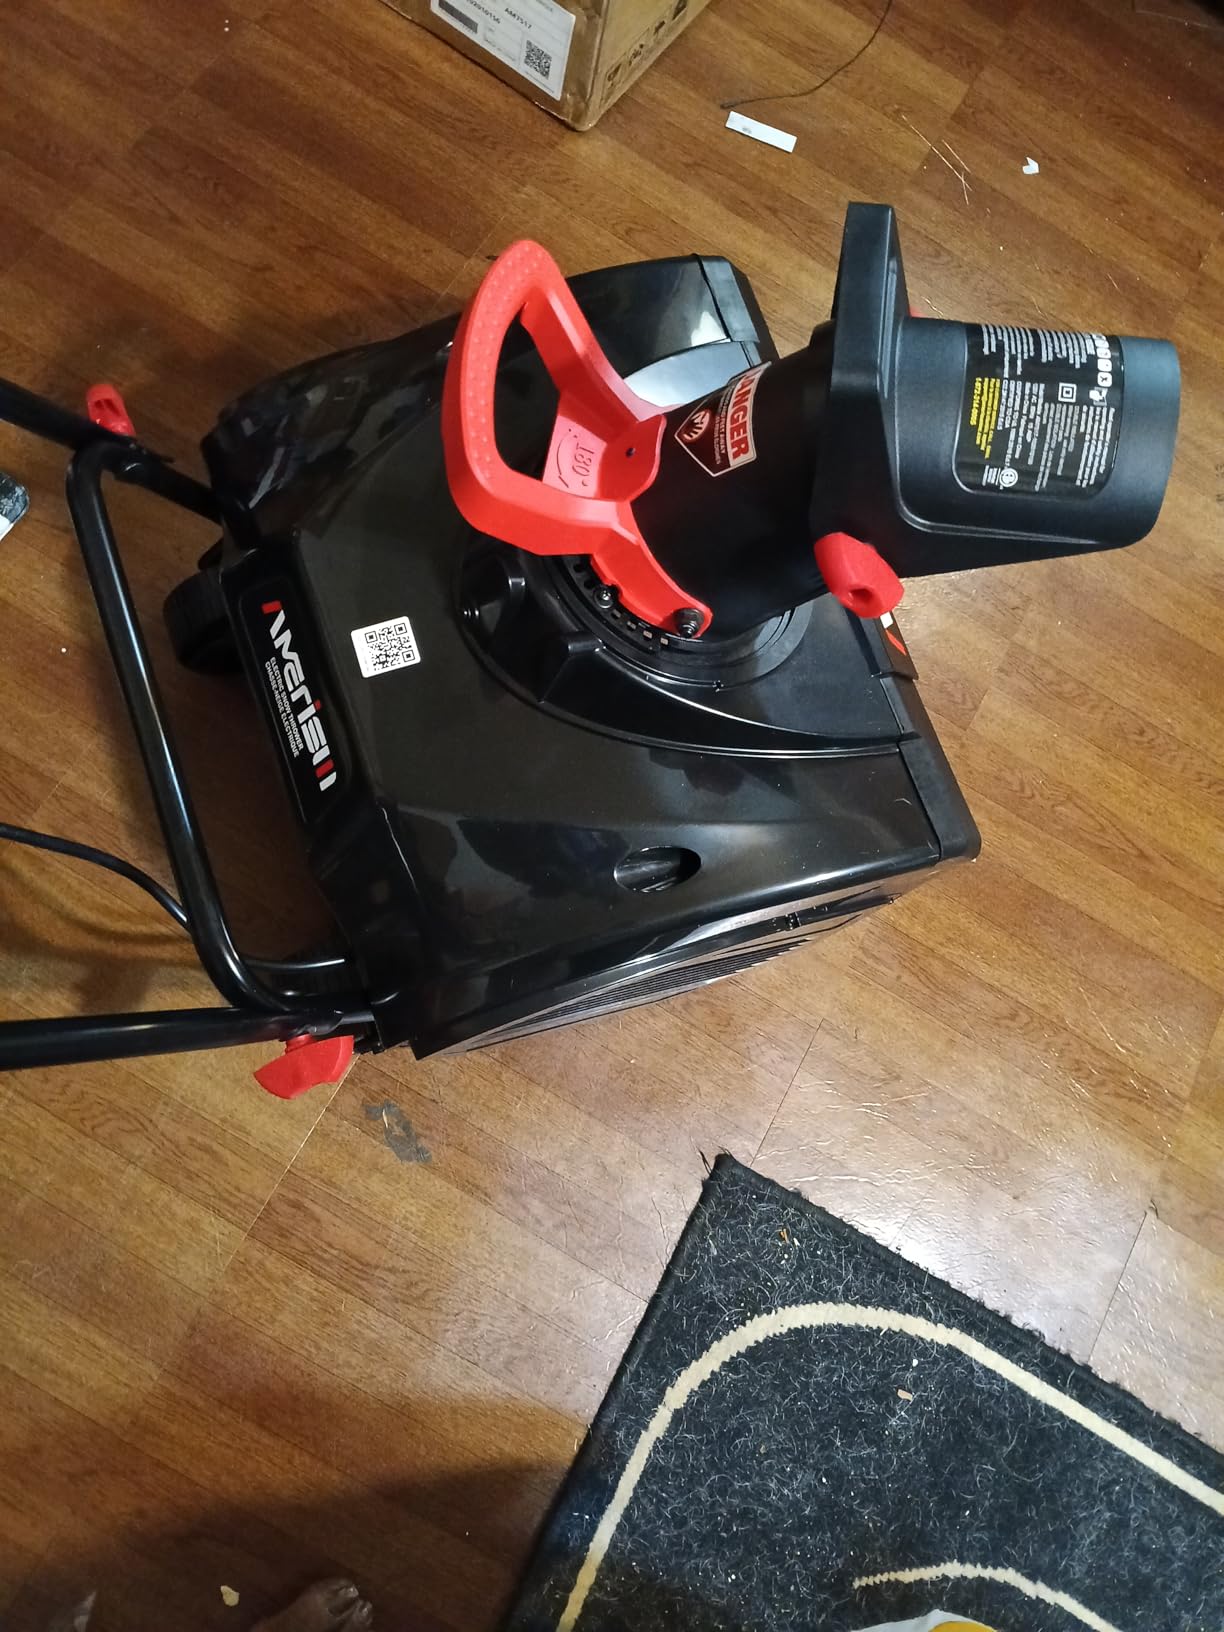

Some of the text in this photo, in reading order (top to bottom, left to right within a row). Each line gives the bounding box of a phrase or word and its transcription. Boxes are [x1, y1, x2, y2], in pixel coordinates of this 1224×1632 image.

[264, 660, 285, 713] CHASSE-NEIGE
[270, 656, 285, 692] ELECTRIC
[288, 712, 304, 750] THROWER
